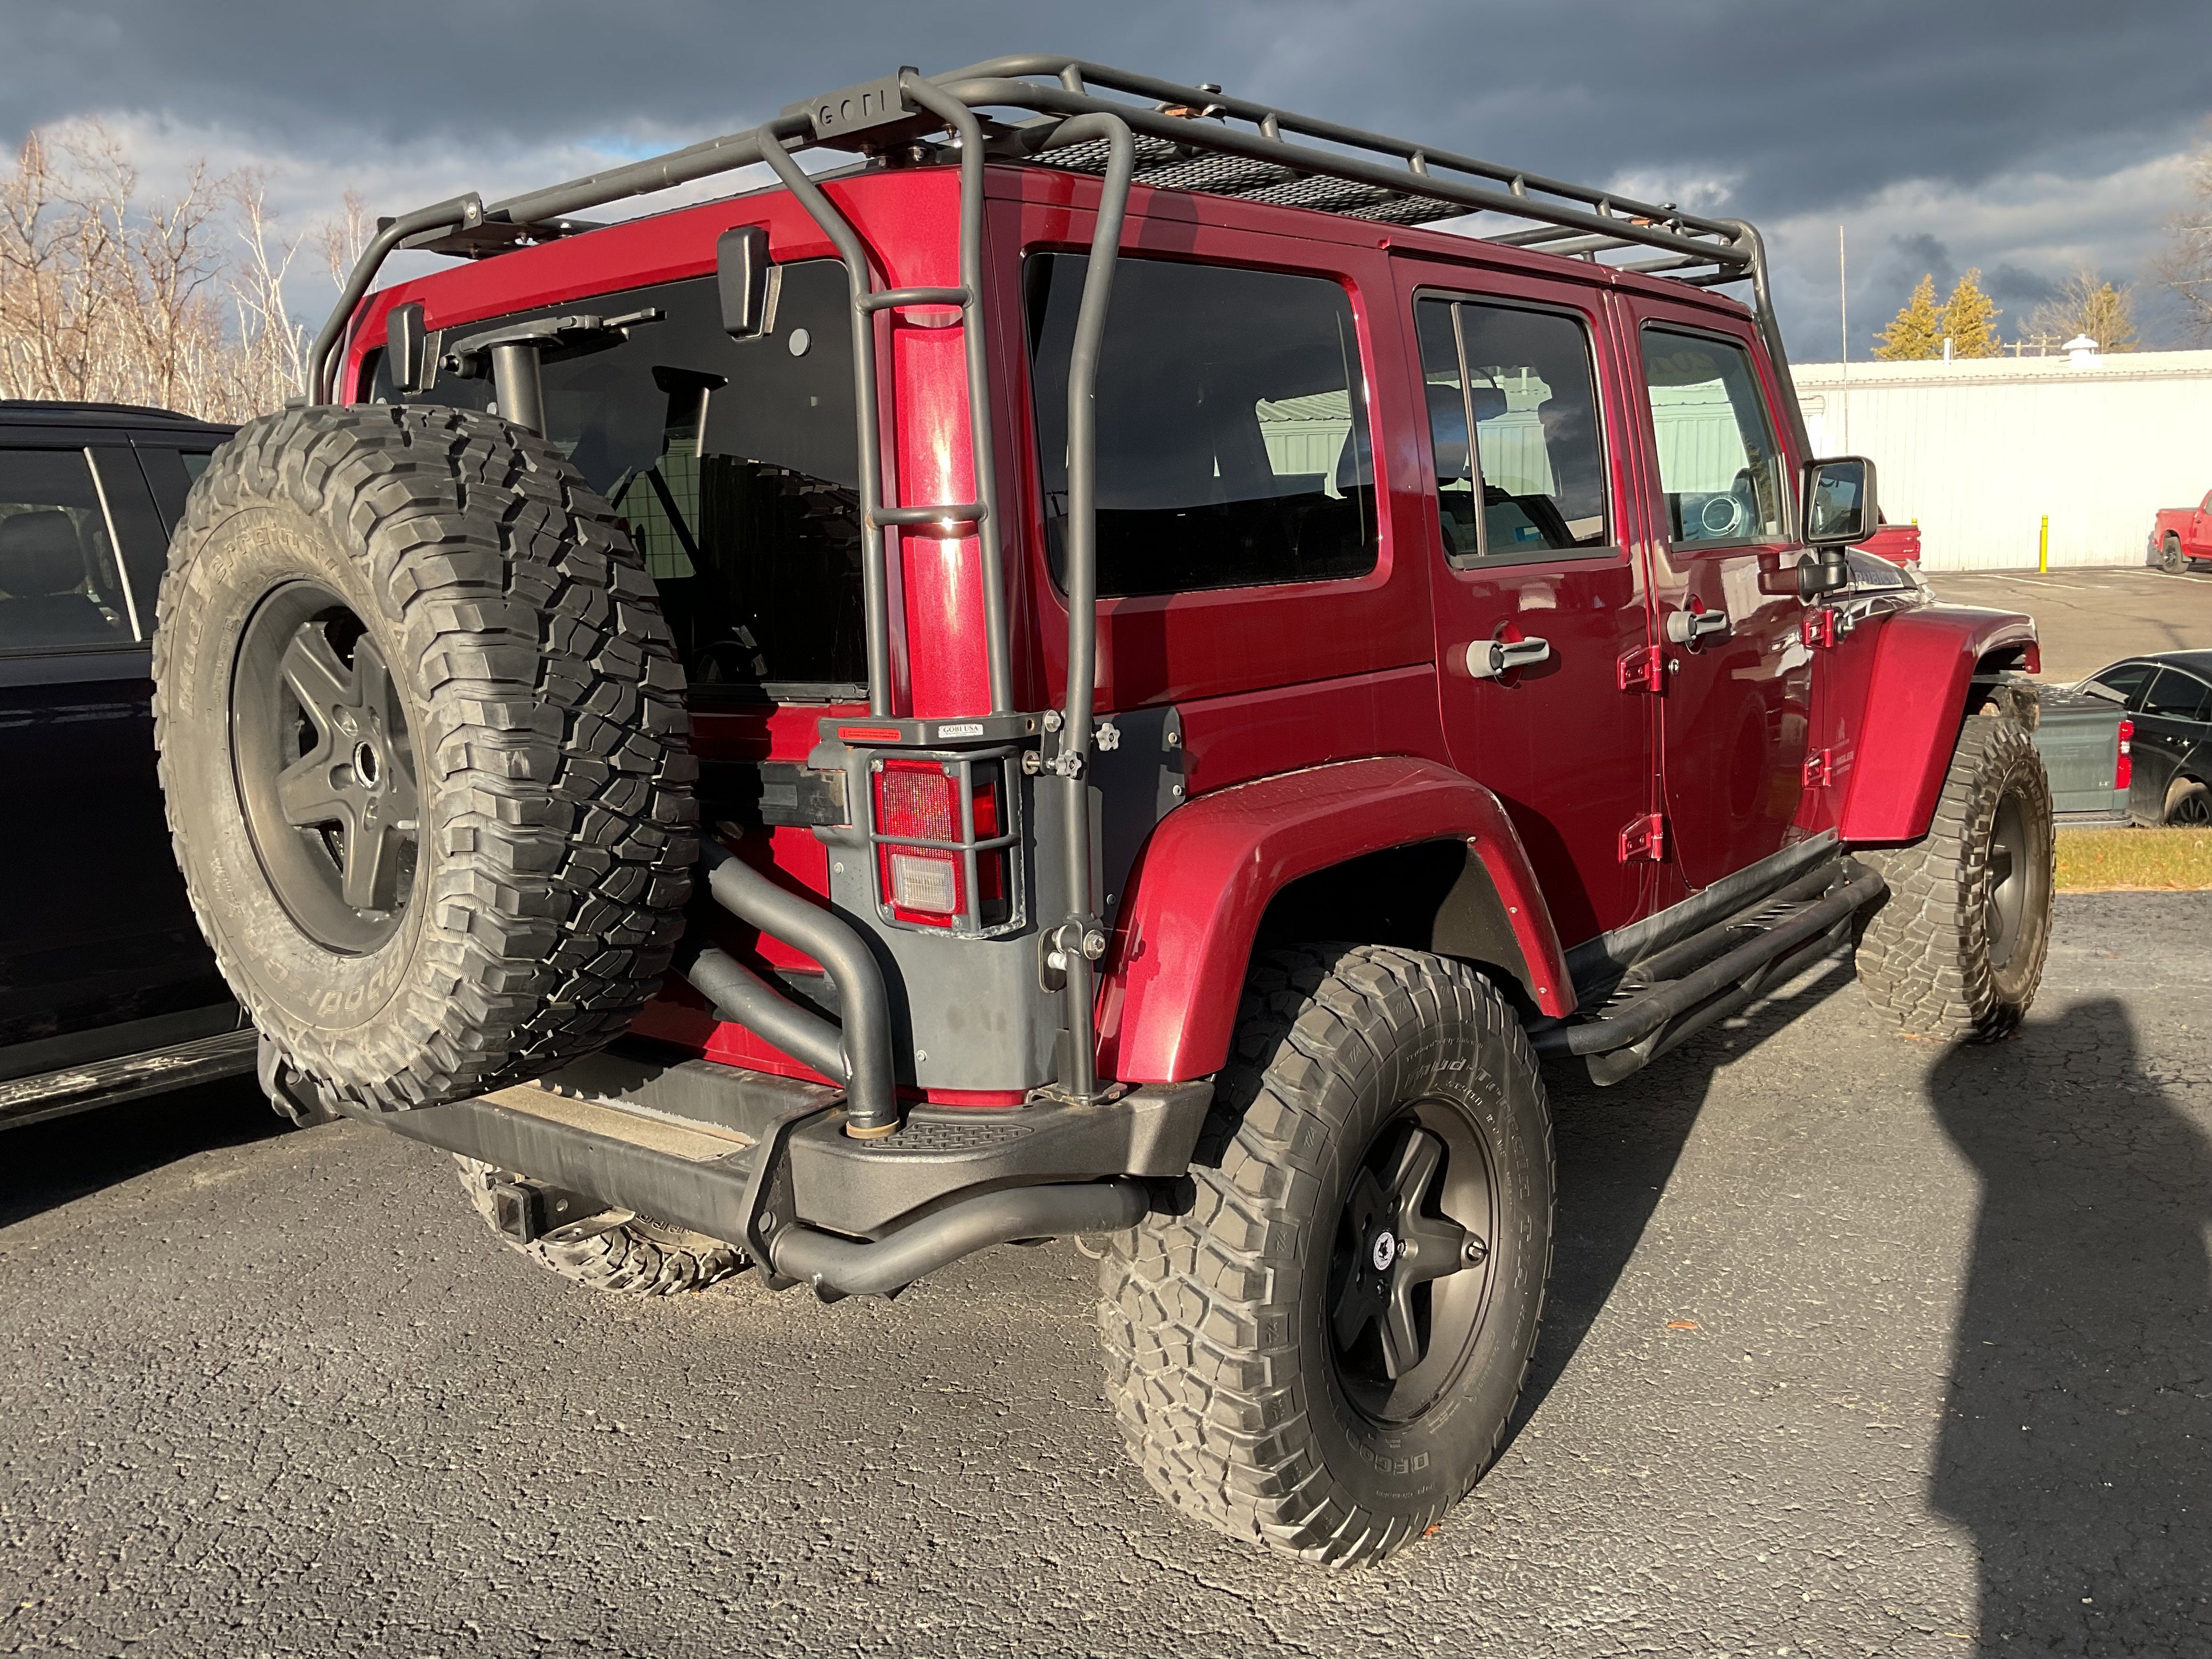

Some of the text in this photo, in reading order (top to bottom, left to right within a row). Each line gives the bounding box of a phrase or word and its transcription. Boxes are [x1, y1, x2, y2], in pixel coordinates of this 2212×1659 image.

[1349, 1044, 1362, 1063] T/A
[1304, 1126, 1316, 1148] T/A
[1277, 1230, 1288, 1252] T/A
